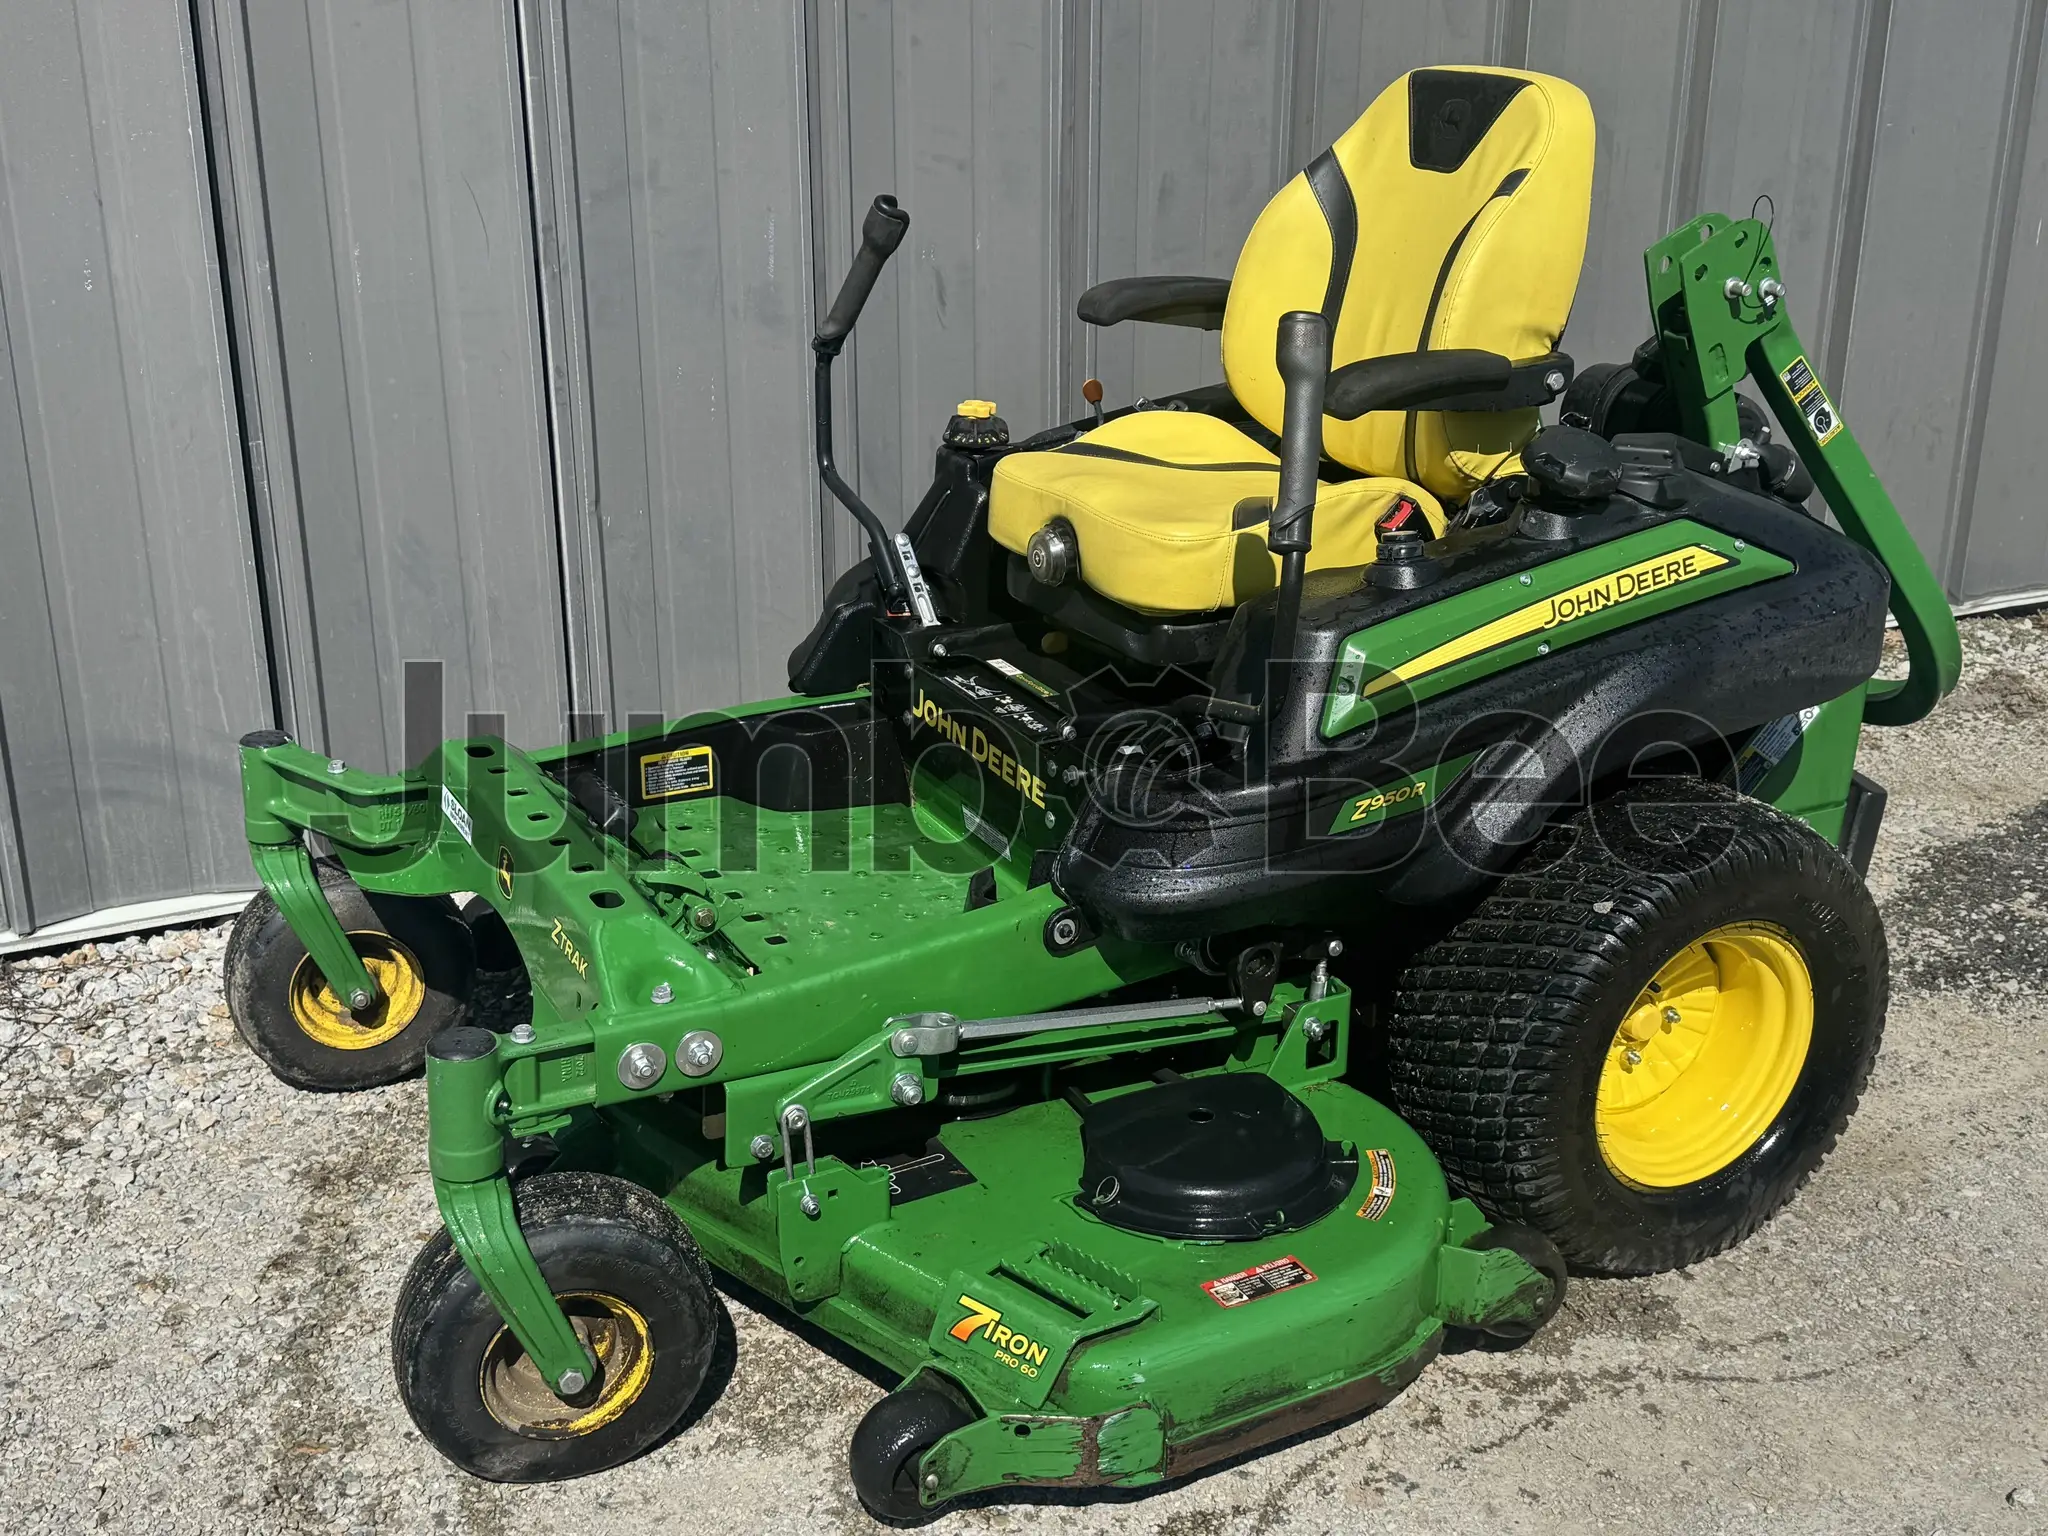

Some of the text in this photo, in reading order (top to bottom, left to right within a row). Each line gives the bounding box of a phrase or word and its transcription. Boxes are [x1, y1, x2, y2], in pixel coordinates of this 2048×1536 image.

[1544, 555, 1697, 625] JOHN DEERE
[912, 689, 1047, 810] JOHN DEERE
[994, 1350, 1038, 1378] PRO 60
